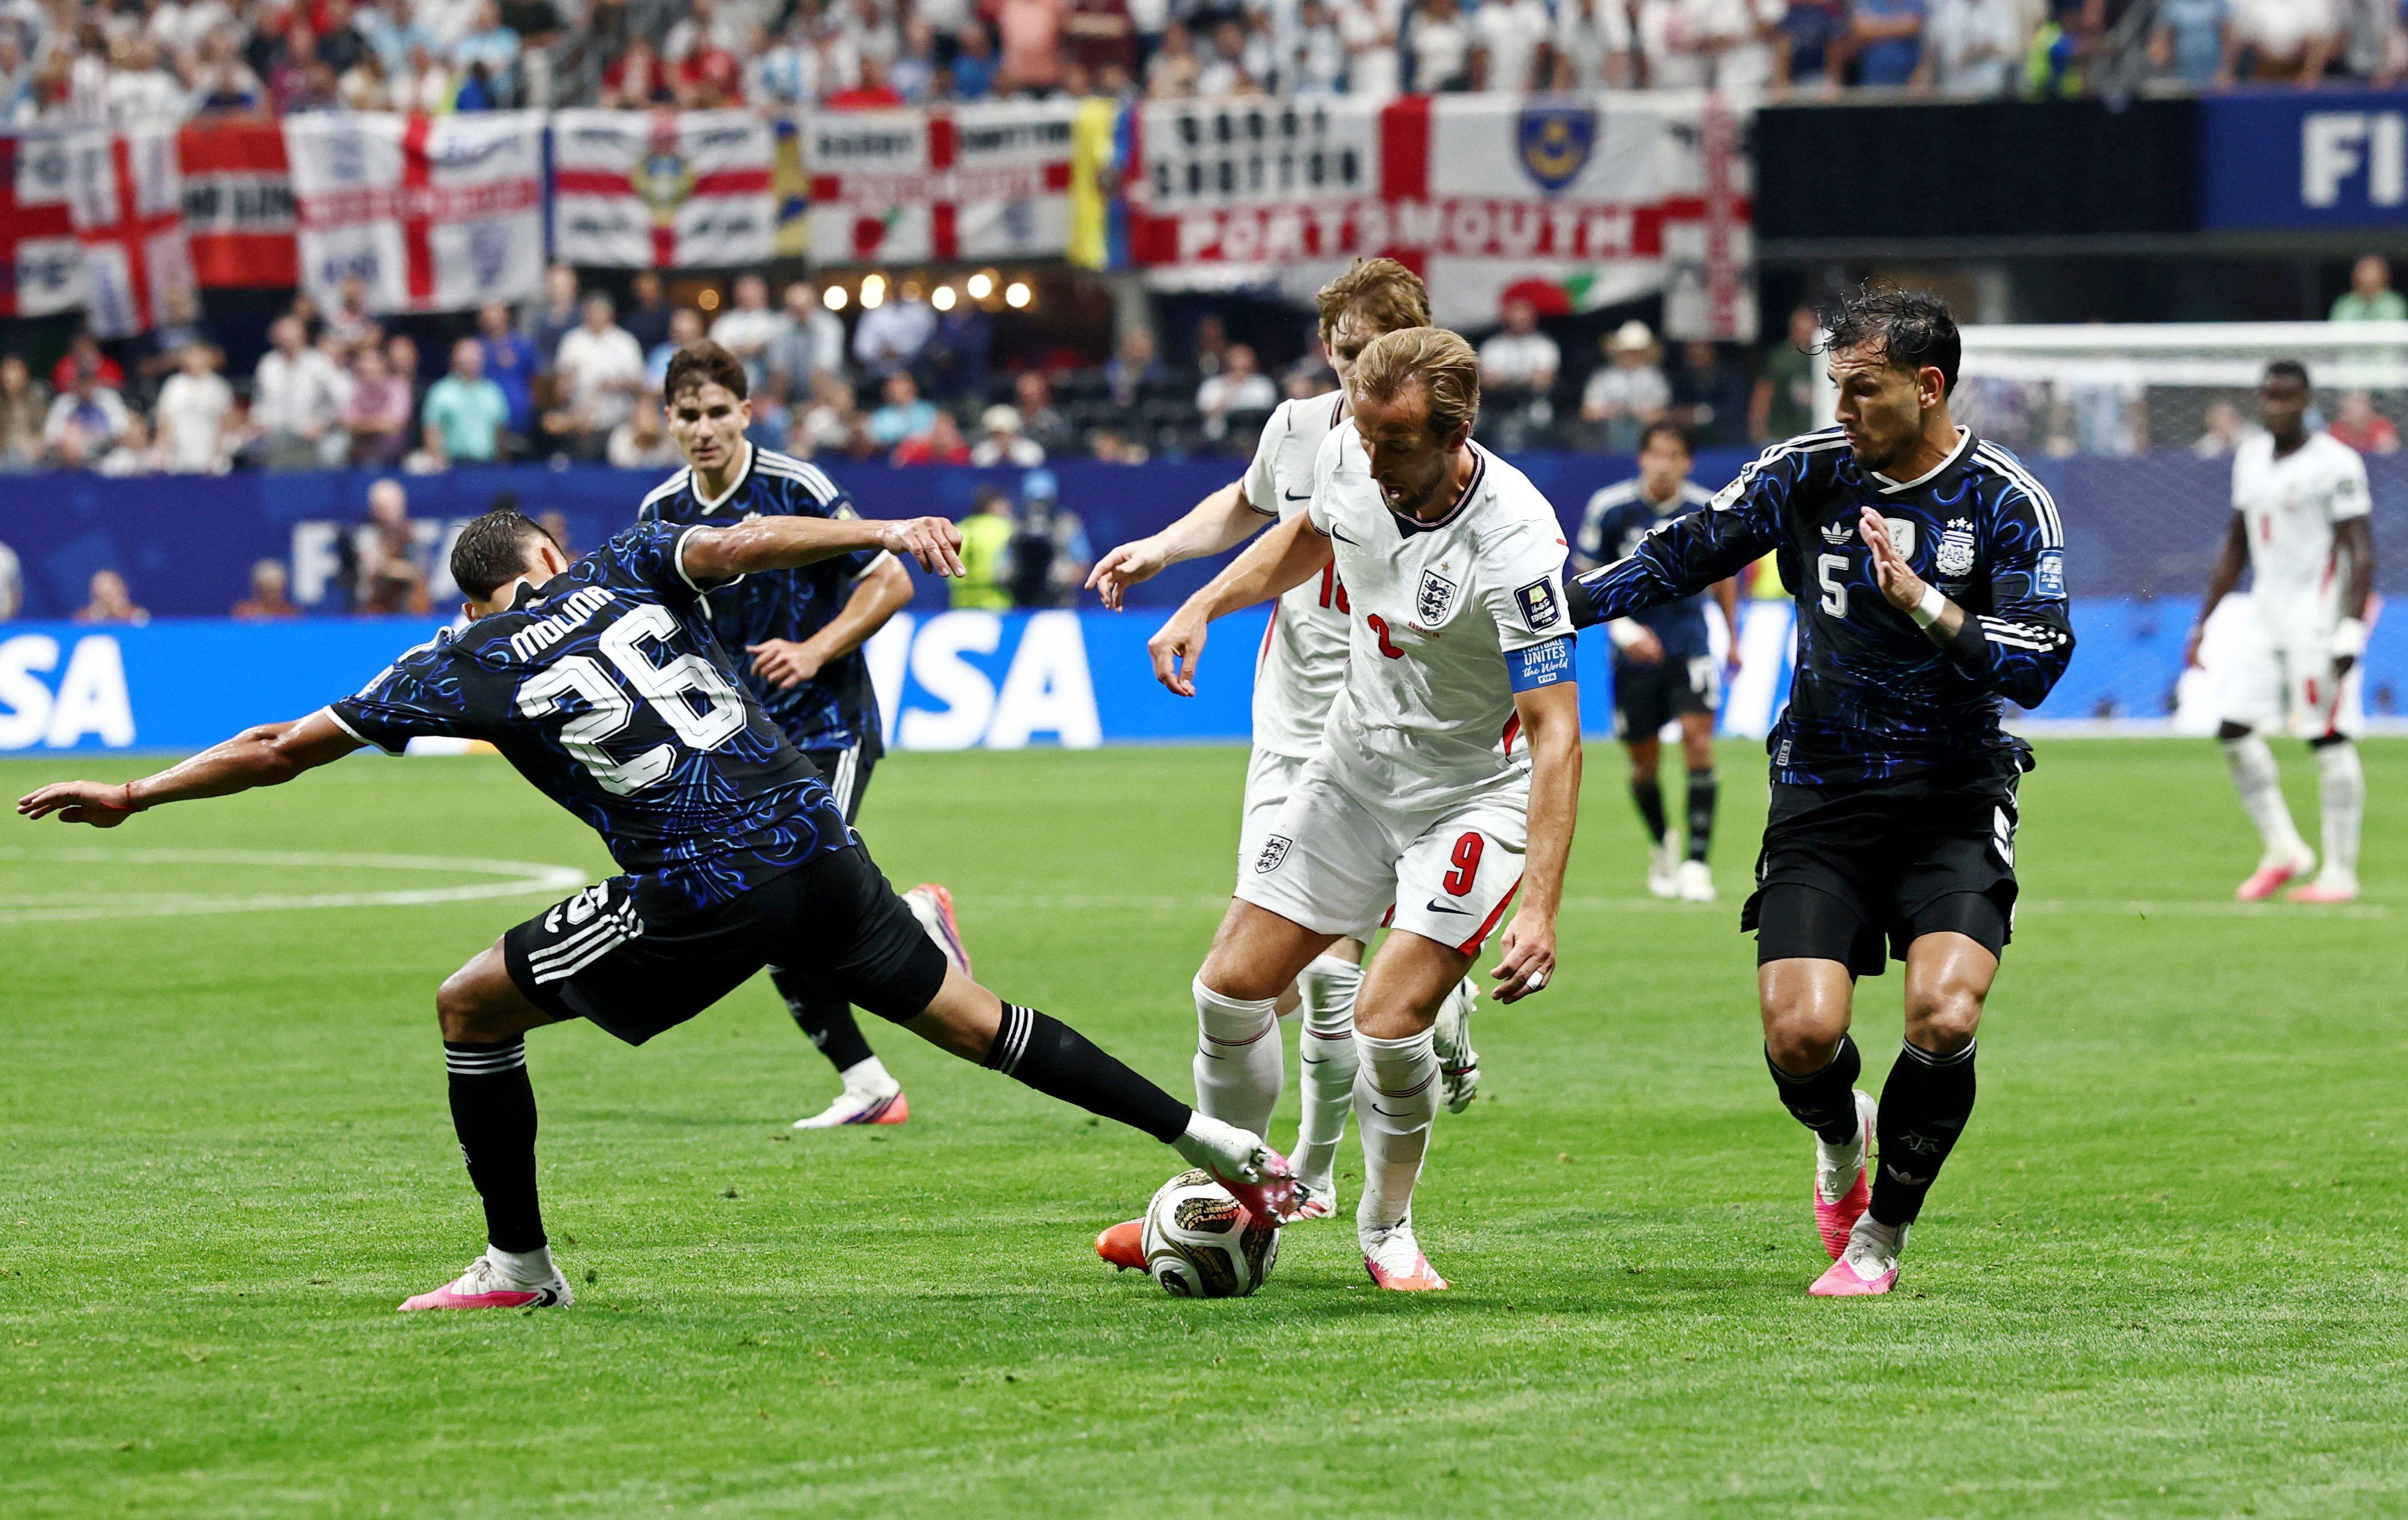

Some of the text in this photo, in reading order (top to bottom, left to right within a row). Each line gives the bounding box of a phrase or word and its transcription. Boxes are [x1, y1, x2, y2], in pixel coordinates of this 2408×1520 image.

[2301, 110, 2405, 208] FI
[1176, 204, 1635, 260] PORTSMOUTH
[1818, 553, 1849, 619] 5
[510, 586, 616, 662] MOLINA
[1524, 646, 1566, 665] UNITES
[0, 634, 137, 750] SA
[516, 603, 747, 797] 26
[864, 609, 1103, 750] ISA
[1522, 658, 1568, 677] the World
[1540, 674, 1555, 682] FIFA
[1443, 832, 1484, 897] 9
[1183, 1208, 1202, 1224] NEW
[1187, 1209, 1240, 1231] ATLANTA
